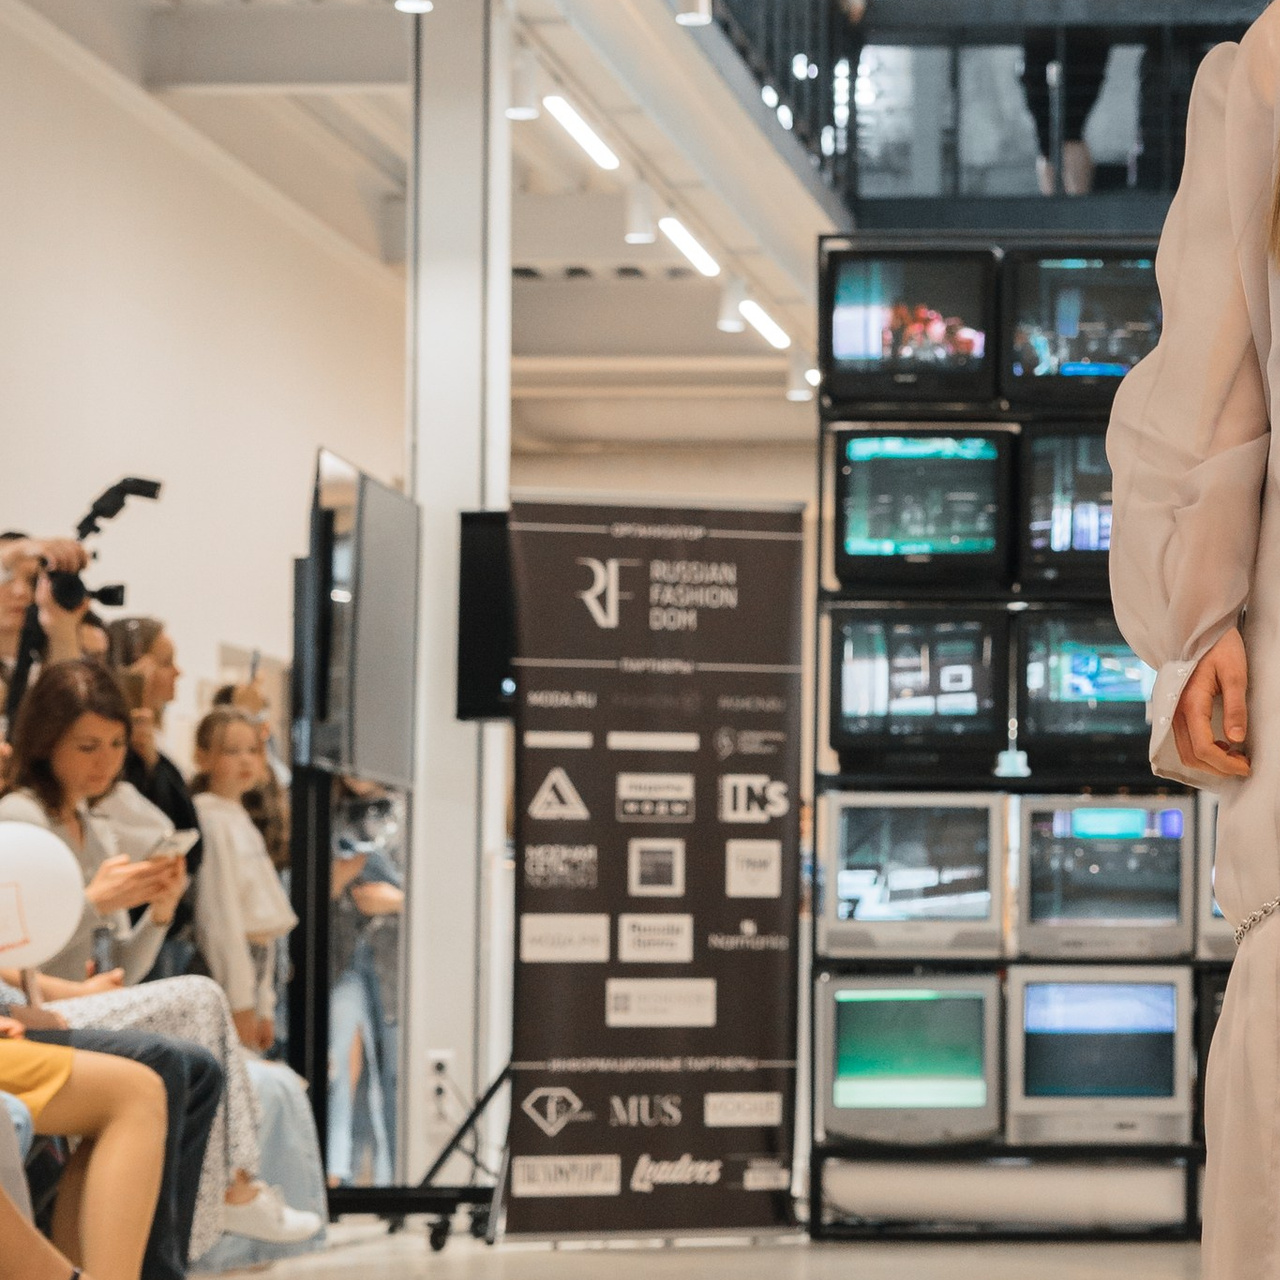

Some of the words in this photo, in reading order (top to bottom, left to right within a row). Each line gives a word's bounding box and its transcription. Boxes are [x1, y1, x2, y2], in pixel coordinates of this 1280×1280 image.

[650, 561, 737, 584] RUSSIAN
[649, 584, 738, 608] FASHION
[649, 607, 697, 631] DOM
[610, 1095, 682, 1126] MUS
